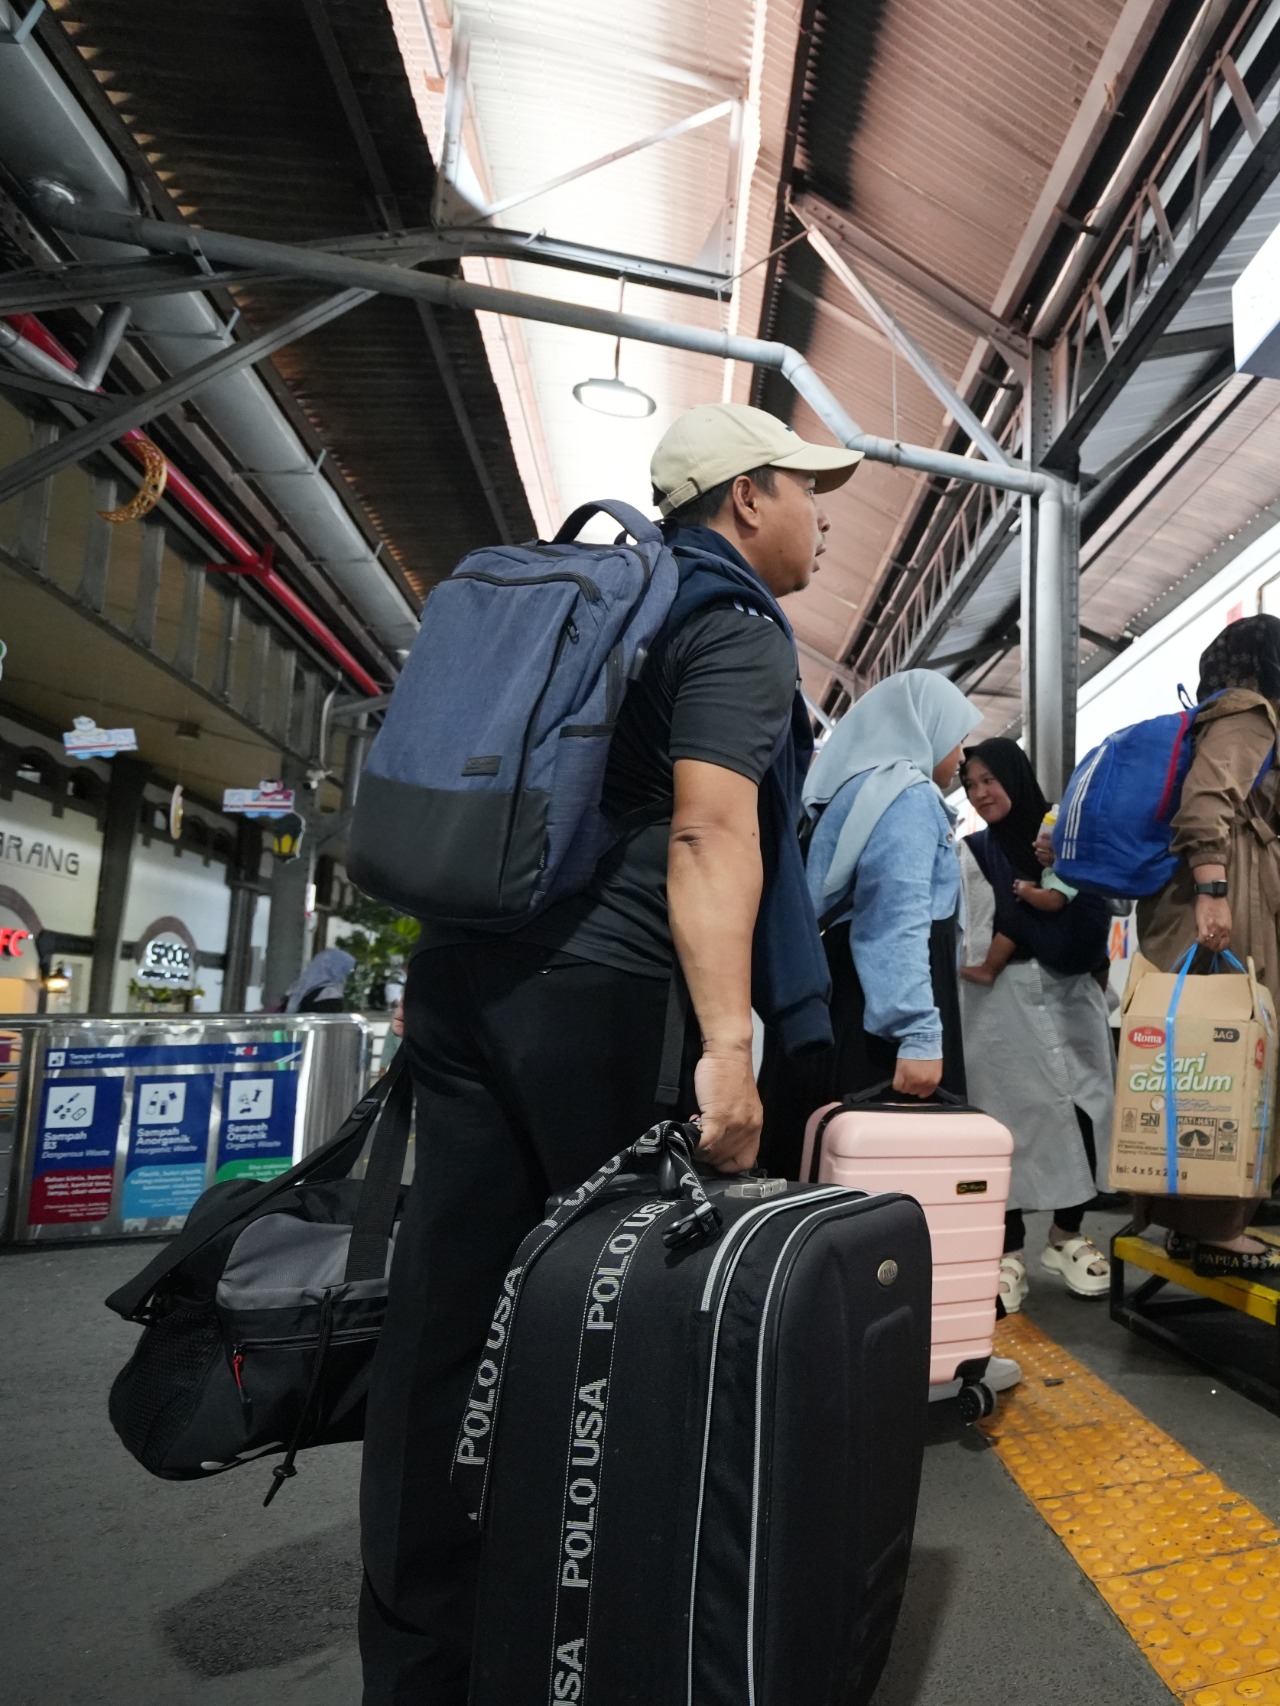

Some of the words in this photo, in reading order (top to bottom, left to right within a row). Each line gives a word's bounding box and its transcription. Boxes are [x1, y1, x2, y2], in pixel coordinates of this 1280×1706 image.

[1133, 1032, 1162, 1044] Roma
[1151, 1052, 1206, 1073] Sari
[1141, 1113, 1160, 1127] SNI
[136, 1127, 180, 1139] Sampah
[227, 1122, 269, 1134] Sampah
[44, 1131, 88, 1143] Sampah
[135, 1135, 191, 1148] Anorganik
[226, 1131, 267, 1143] Organik
[42, 1141, 57, 1151] B3
[225, 1141, 256, 1151] Organic
[41, 1151, 84, 1160] Dangerous
[85, 1149, 111, 1157] Waste
[1116, 1165, 1130, 1174] Isi:
[1131, 1166, 1138, 1174] 4
[1147, 1167, 1153, 1176] 5
[1199, 1253, 1239, 1268] PAPUA
[587, 1234, 638, 1330] POLO
[456, 1359, 499, 1465] POLO
[486, 1266, 524, 1350] USA
[571, 1378, 608, 1467] USA
[561, 1477, 598, 1588] POLO
[552, 1638, 586, 1706] SA
